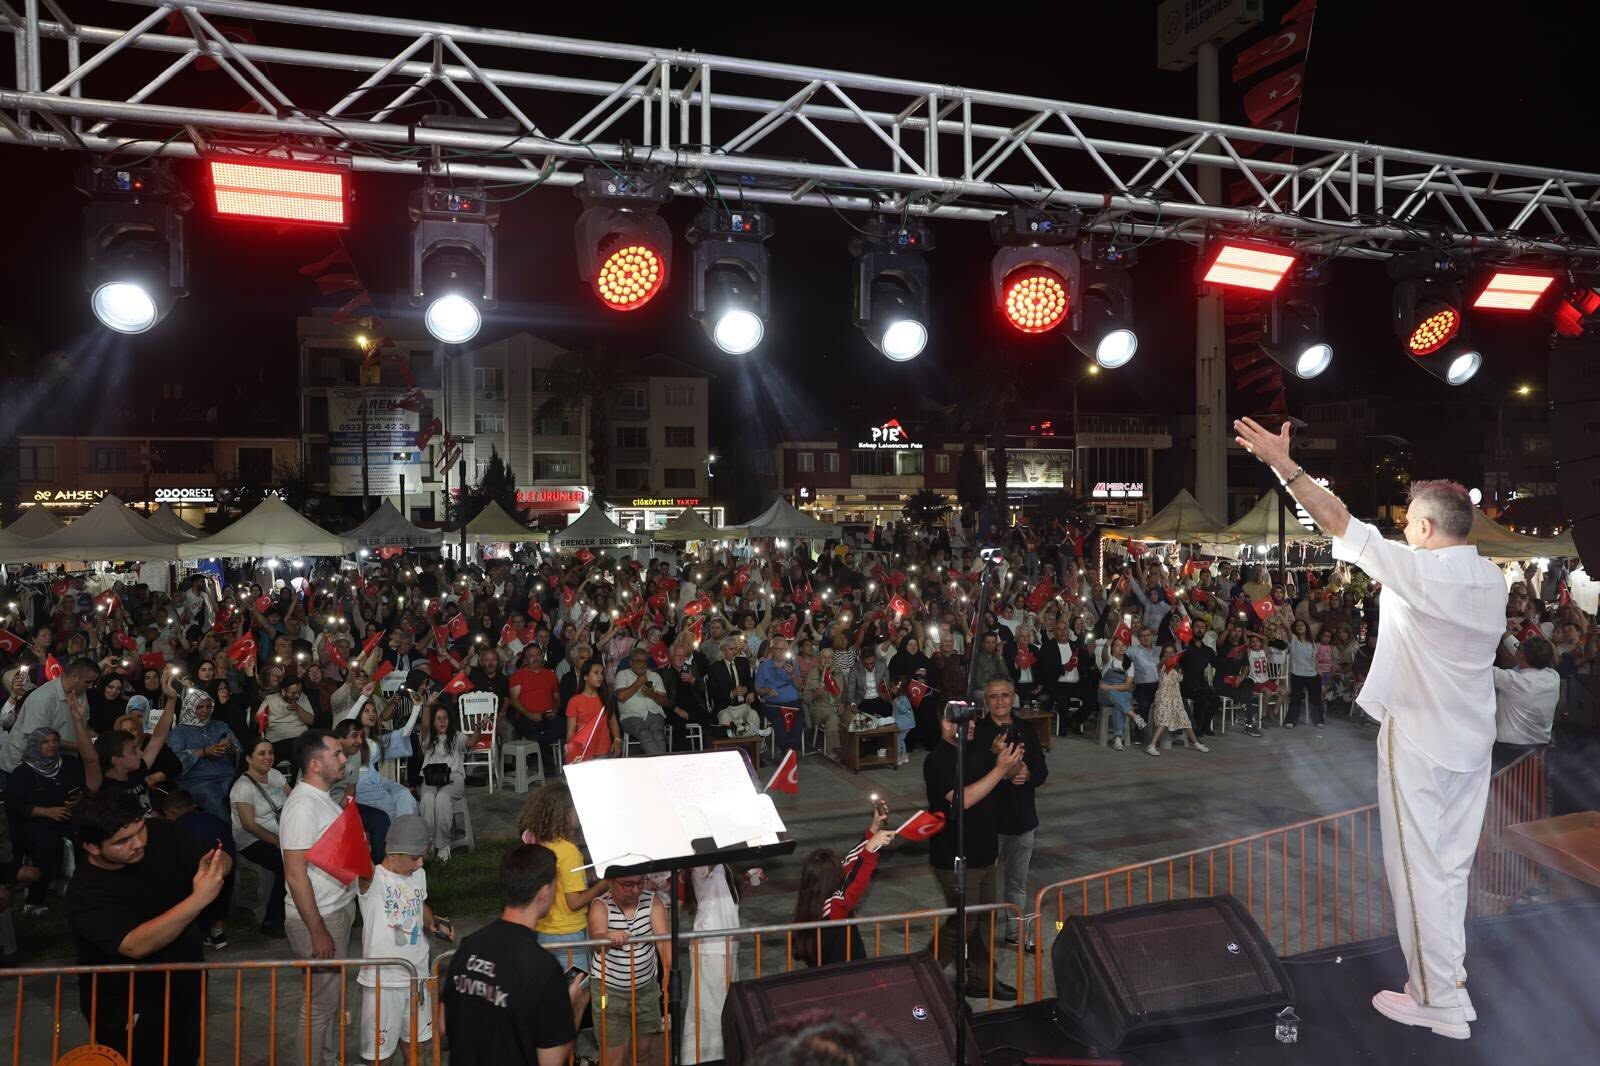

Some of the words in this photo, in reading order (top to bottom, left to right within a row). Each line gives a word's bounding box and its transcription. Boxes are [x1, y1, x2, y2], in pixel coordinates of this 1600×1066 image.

[1107, 483, 1144, 491] MERCAN
[54, 490, 104, 501] AHSEN
[561, 538, 595, 547] ERENLER
[467, 954, 497, 978] ÖZEL
